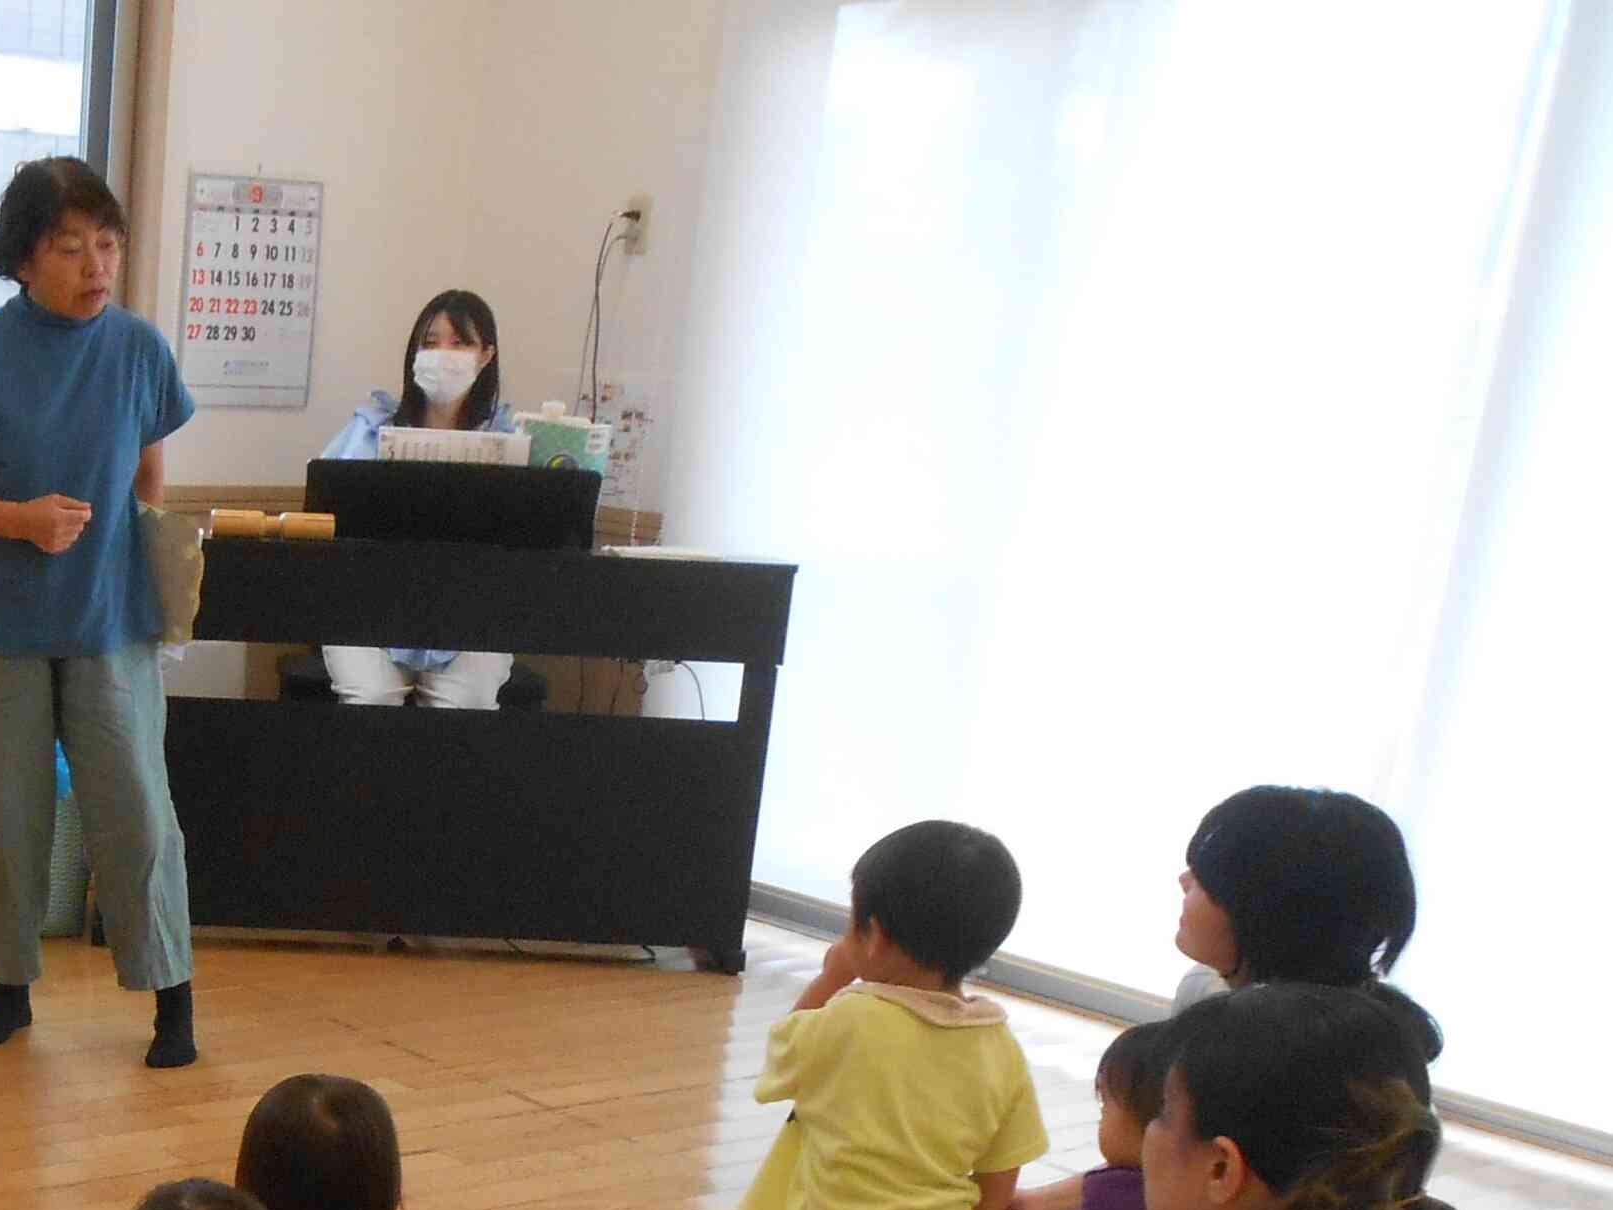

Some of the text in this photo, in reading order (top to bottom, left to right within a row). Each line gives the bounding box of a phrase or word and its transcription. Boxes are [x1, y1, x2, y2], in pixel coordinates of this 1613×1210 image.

[251, 185, 263, 203] 9
[234, 215, 240, 232] 1
[251, 217, 259, 233] 2
[270, 217, 278, 234] 3
[288, 219, 296, 236] 4
[196, 241, 204, 257] 6
[214, 242, 221, 259] 7
[231, 243, 239, 259] 8
[250, 244, 258, 261] 9
[265, 244, 278, 261] 10
[284, 245, 296, 262] 11
[192, 269, 205, 285] 13
[210, 270, 223, 286] 14
[228, 270, 240, 286] 15
[246, 271, 258, 287] 16
[263, 272, 277, 288] 17
[282, 273, 295, 289] 18
[189, 297, 203, 312] 20
[209, 297, 221, 313] 21
[226, 298, 239, 314] 22
[244, 299, 258, 315] 23
[261, 300, 275, 316] 24
[279, 301, 293, 317] 25
[187, 324, 256, 342] 27 28 29 30
